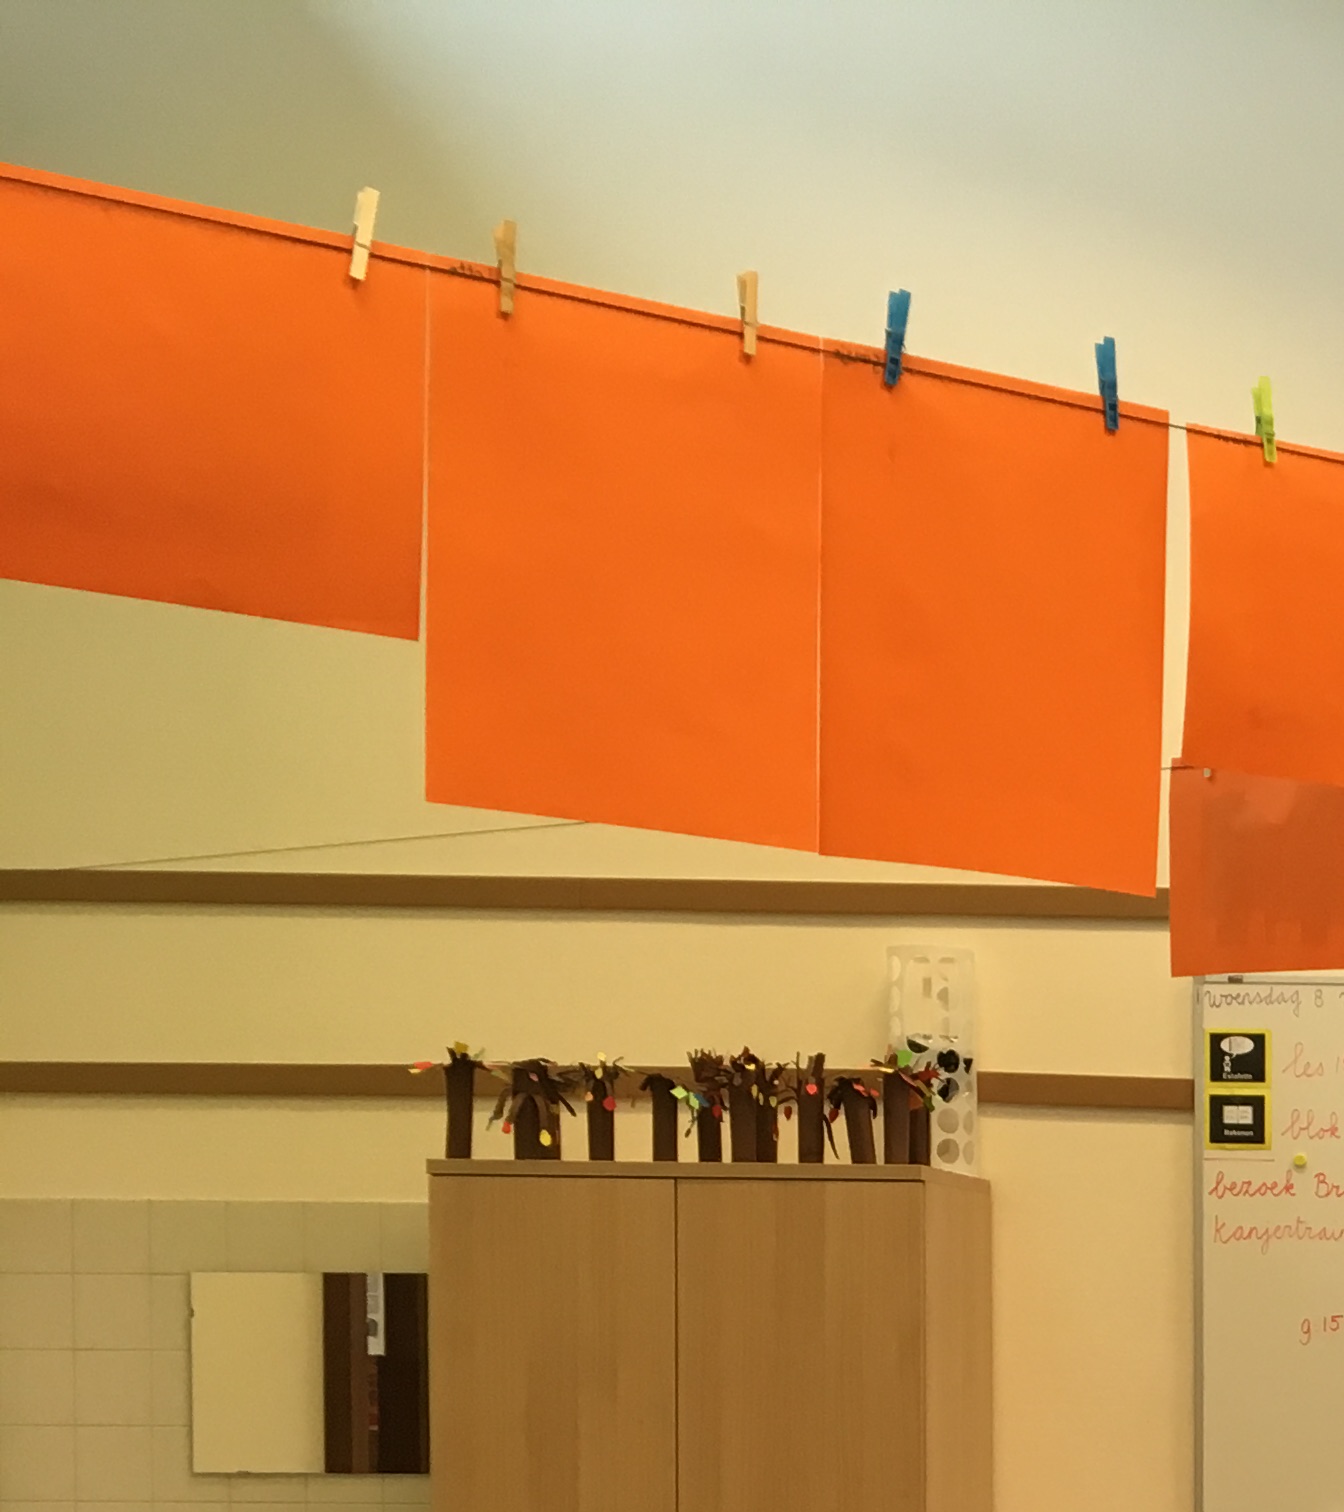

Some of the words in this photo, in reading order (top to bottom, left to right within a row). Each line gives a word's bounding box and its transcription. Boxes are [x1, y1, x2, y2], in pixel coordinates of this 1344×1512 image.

[1203, 986, 1303, 1018] woensdag
[1314, 988, 1325, 1009] 8
[1281, 1041, 1325, 1078] les
[1280, 1108, 1341, 1141] blok
[1208, 1168, 1297, 1200] bezoek
